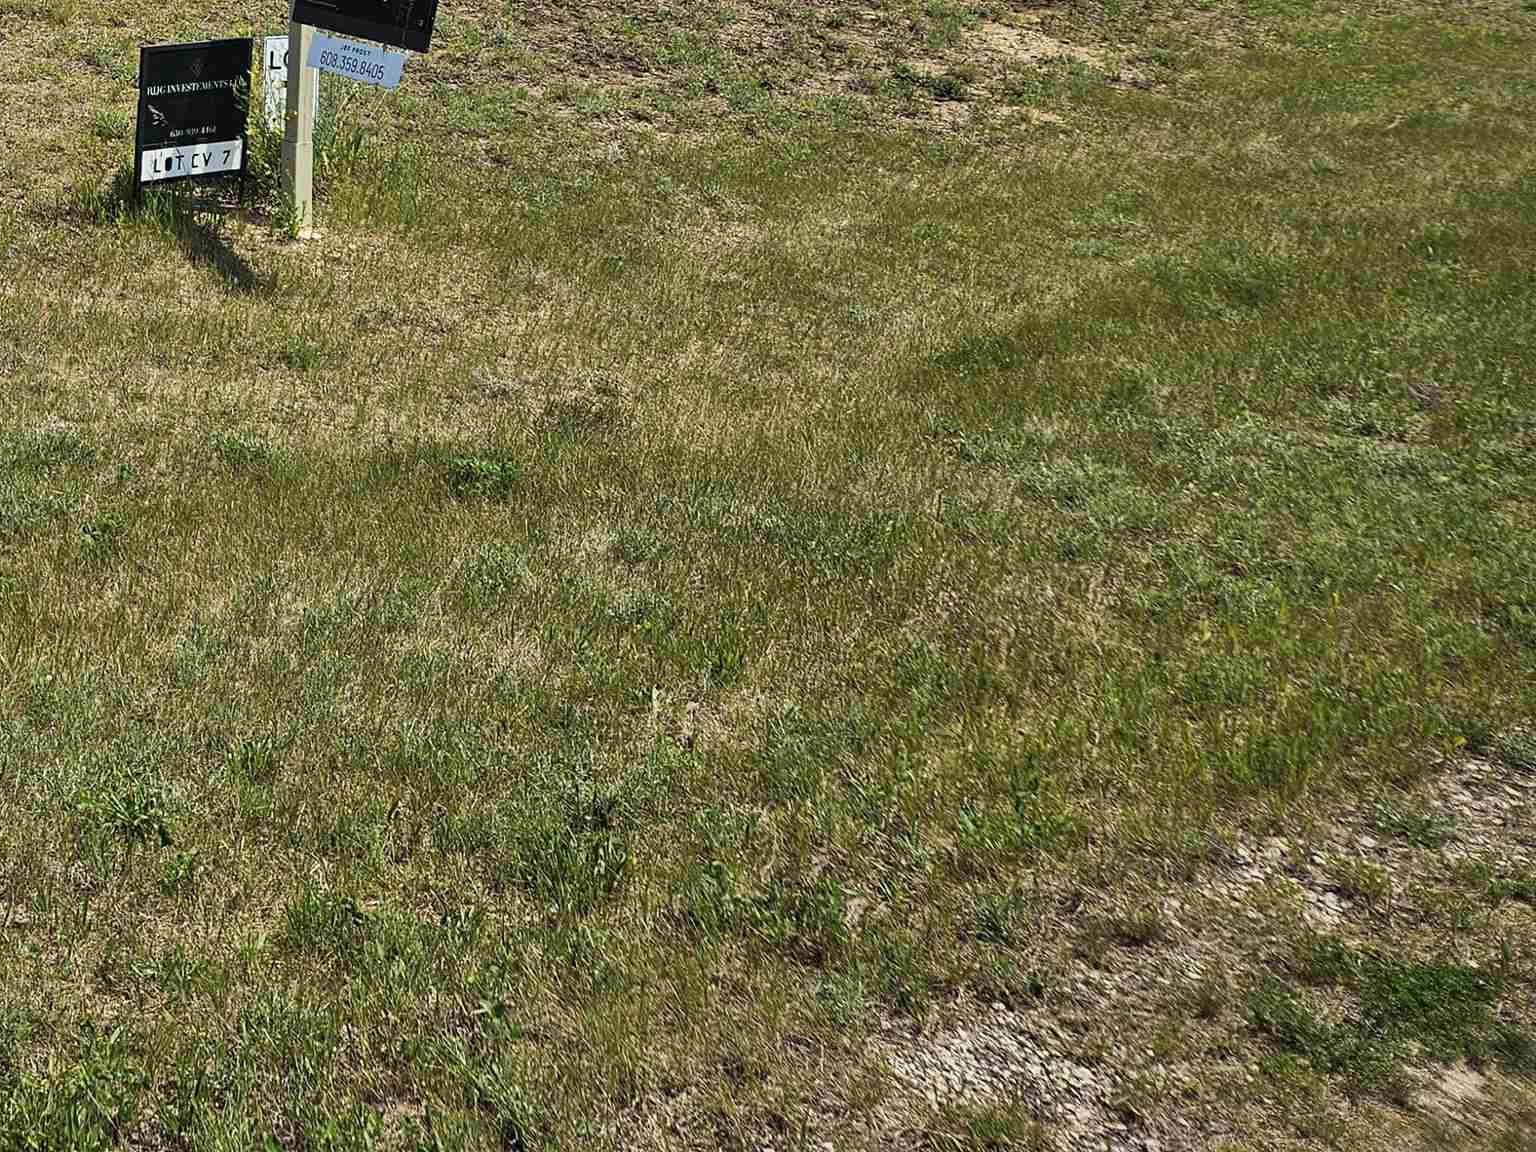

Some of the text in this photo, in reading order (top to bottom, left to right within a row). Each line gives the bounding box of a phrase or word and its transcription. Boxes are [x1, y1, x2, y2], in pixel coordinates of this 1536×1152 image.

[320, 50, 384, 80] 608.359.8405
[153, 154, 185, 173] LOT
[223, 149, 232, 165] 7
